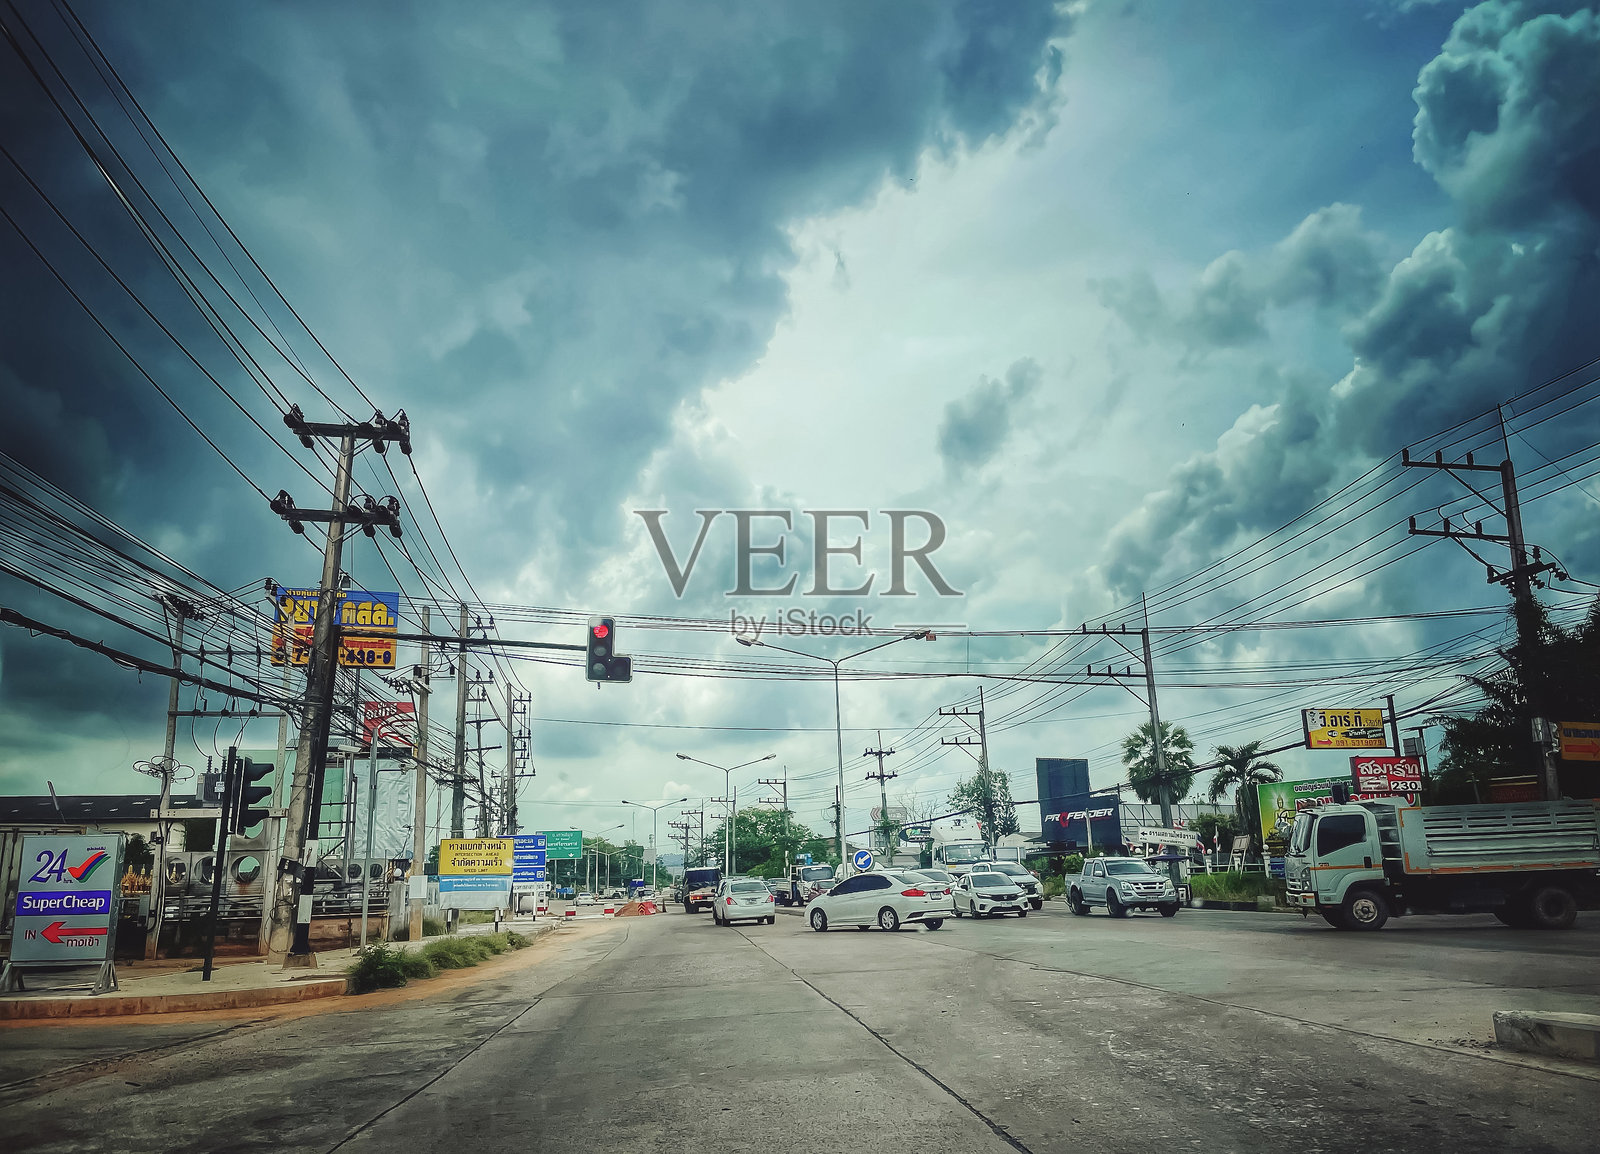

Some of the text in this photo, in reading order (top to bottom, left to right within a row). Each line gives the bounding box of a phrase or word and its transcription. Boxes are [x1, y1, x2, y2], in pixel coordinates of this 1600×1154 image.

[1045, 807, 1114, 827] PROFENDER
[449, 841, 507, 851] ทางแยกข้างหน้า
[28, 848, 69, 884] 24
[451, 857, 503, 867] จำกัดความเร็ว
[22, 895, 105, 912] SuperCheap
[24, 929, 37, 940] IN
[66, 936, 100, 947] ทางเข้า
